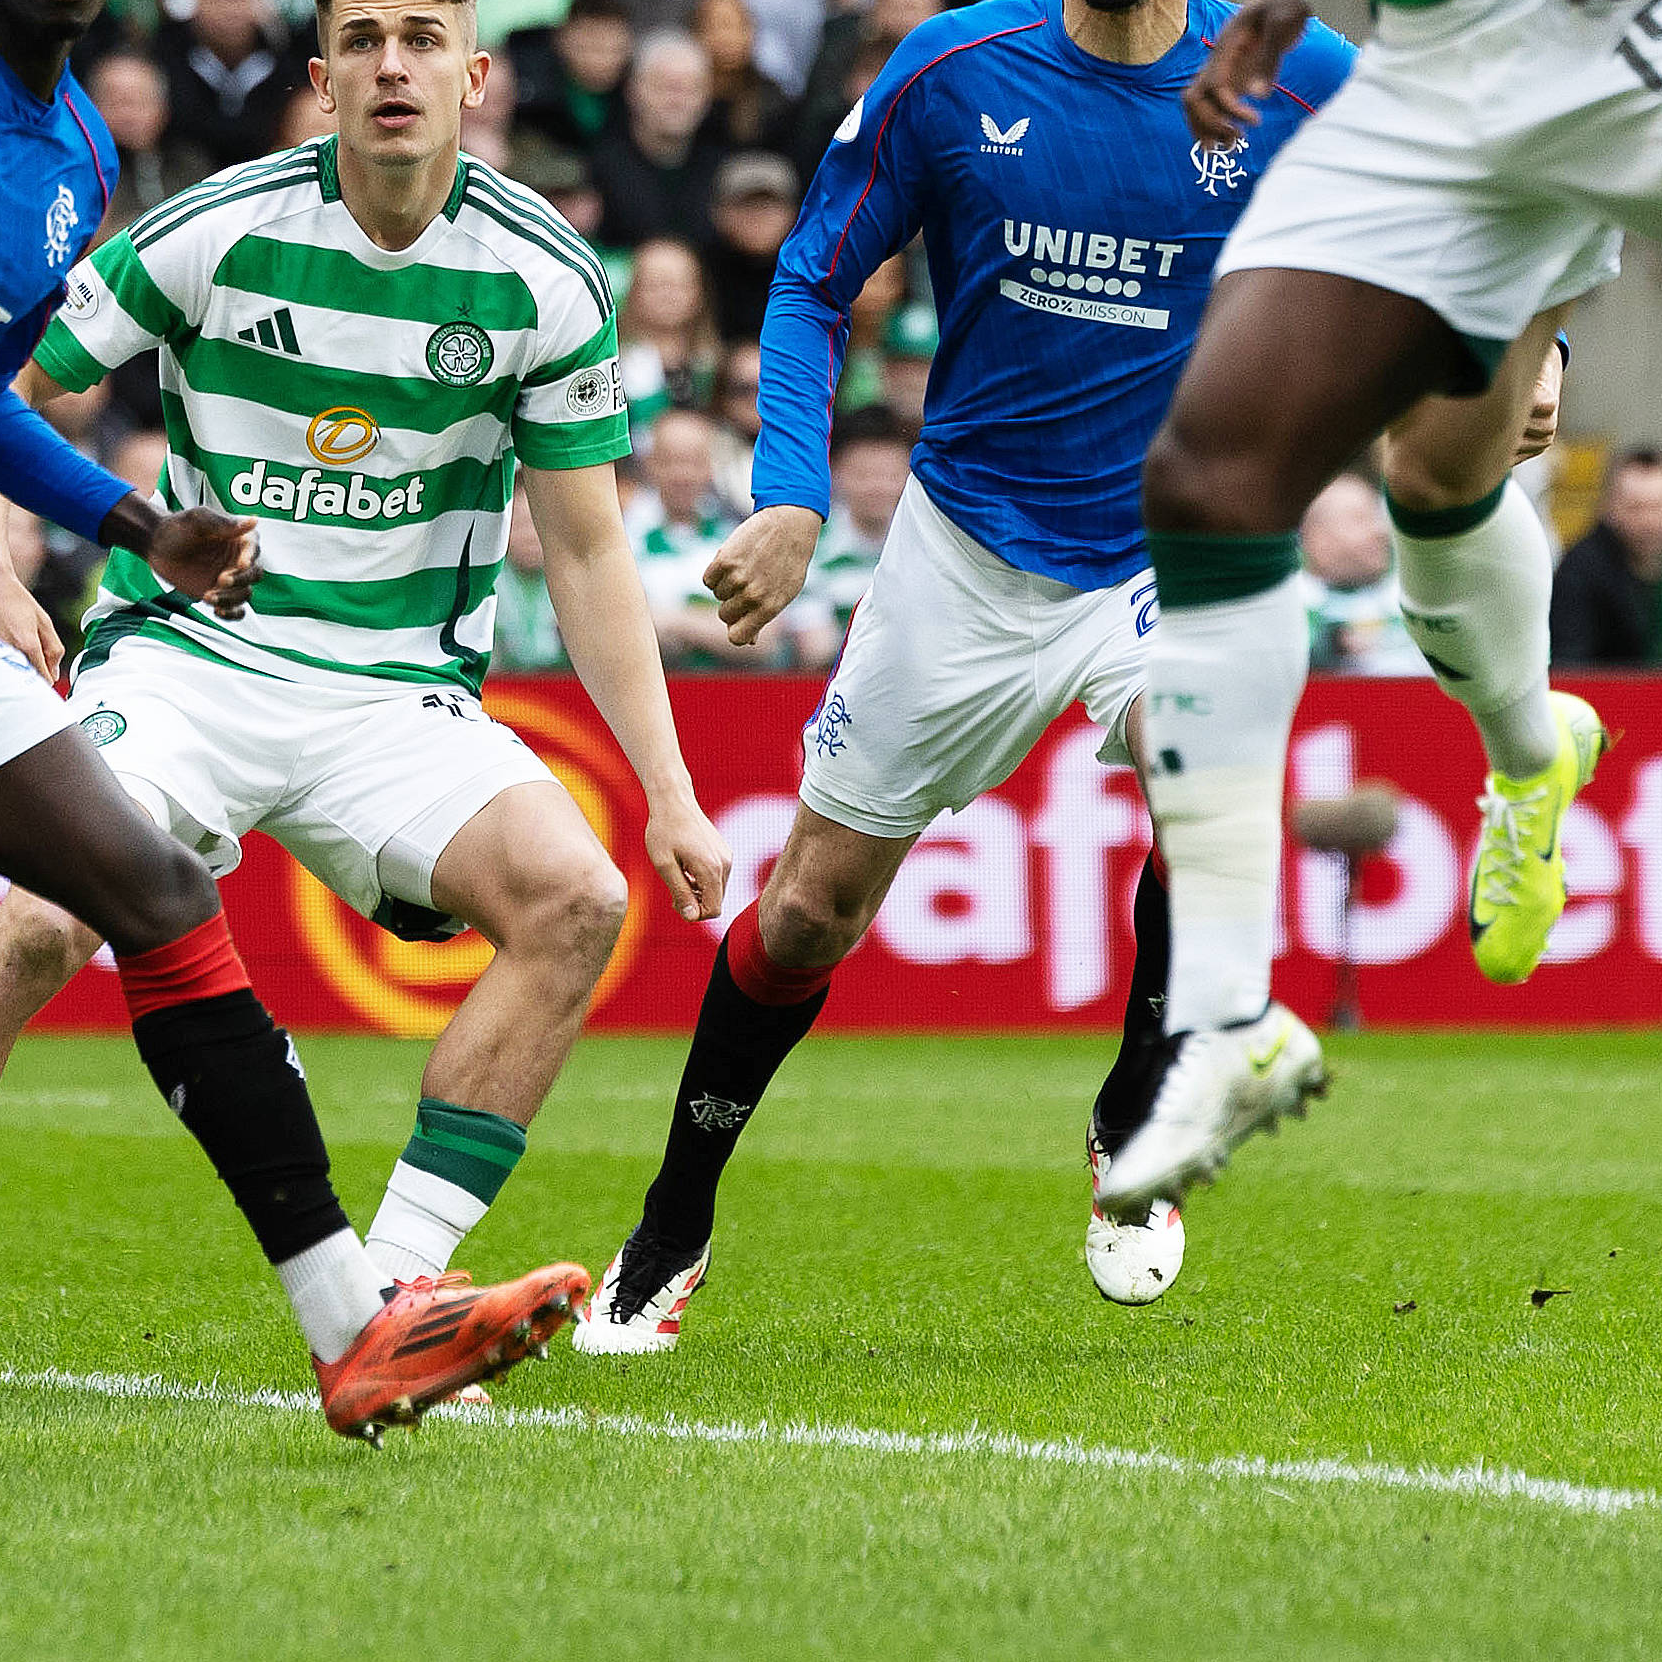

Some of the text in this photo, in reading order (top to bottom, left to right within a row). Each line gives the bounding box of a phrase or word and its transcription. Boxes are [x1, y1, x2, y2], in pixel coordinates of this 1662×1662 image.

[980, 144, 1024, 157] CASTORE
[1004, 218, 1184, 277] UNIBET
[77, 282, 94, 304] HILL
[1019, 287, 1146, 324] ZERO% MISSON
[229, 460, 425, 521] dafabet
